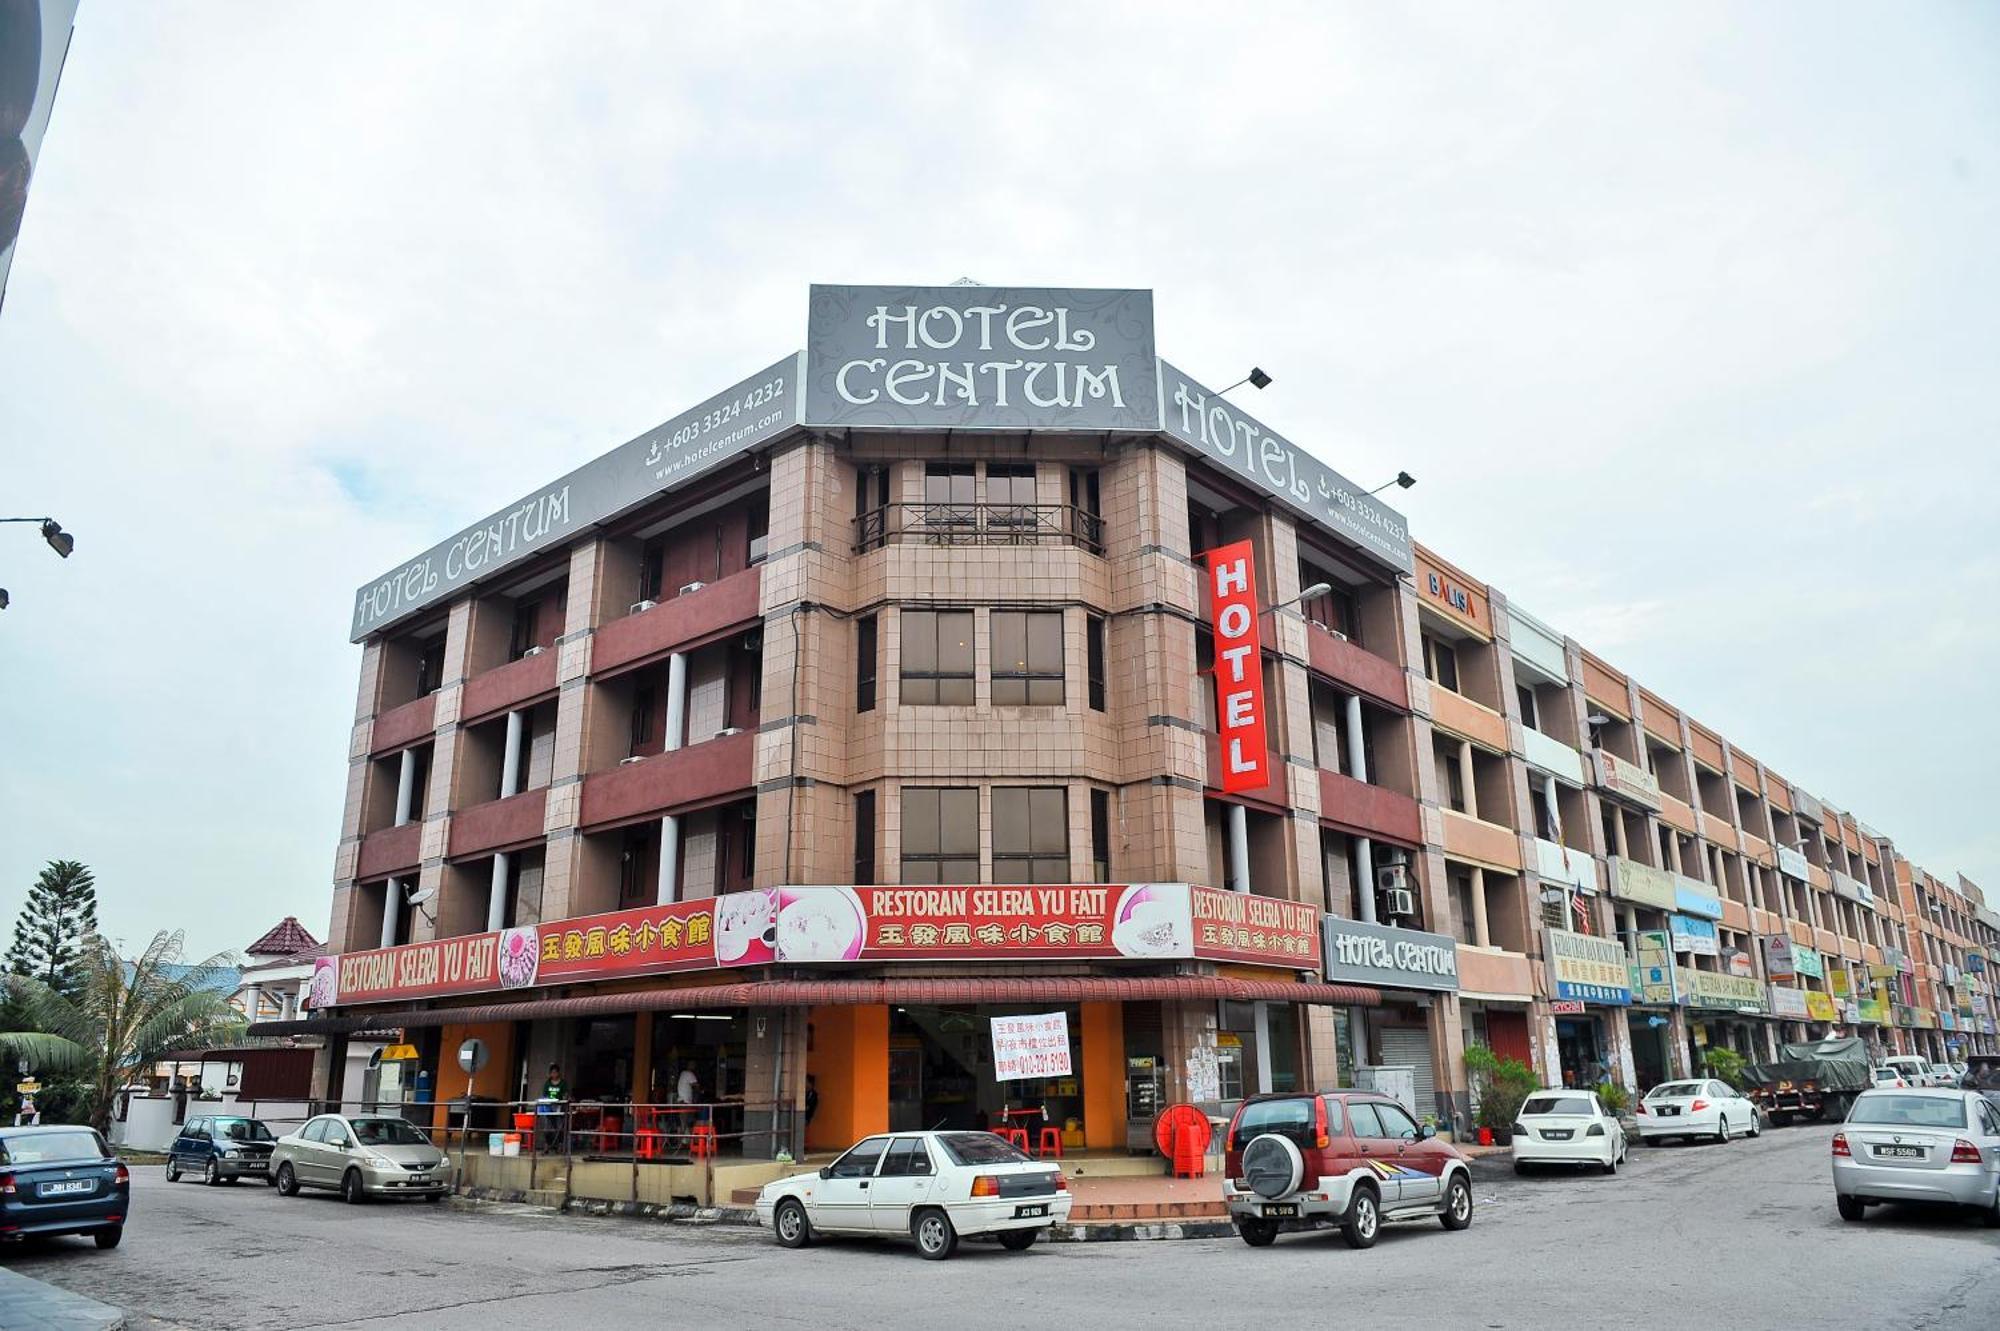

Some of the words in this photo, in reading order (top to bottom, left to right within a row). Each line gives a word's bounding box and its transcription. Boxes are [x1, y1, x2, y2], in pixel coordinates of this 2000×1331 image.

[866, 304, 1096, 351] HOTEL
[835, 358, 1126, 408] CENTUM
[663, 421, 700, 452] +603
[703, 399, 741, 434] 3324
[743, 377, 784, 411] 4232
[655, 410, 782, 480] www.hotelcentum.com
[1174, 381, 1311, 503] HOTEL
[1331, 488, 1356, 512] +603
[1358, 500, 1382, 528] 3324
[1383, 519, 1407, 543] 4232
[359, 556, 438, 627] HOTEL
[446, 484, 570, 580] CENTUM
[1429, 573, 1476, 618] BALISA
[1216, 557, 1258, 774] HOTEL
[872, 890, 967, 917] RESTORAN
[973, 890, 1035, 917] SELERA
[1038, 890, 1065, 916] YU
[1070, 889, 1108, 916] FATT
[1193, 891, 1247, 925] RESTORAN
[1248, 899, 1281, 930] SELERA
[1281, 904, 1296, 932] YU
[1297, 906, 1316, 935] FATT
[540, 911, 713, 961] 玉發風味小食館
[877, 923, 1105, 946] 玉發風味小食館
[1335, 933, 1393, 969] HOTEL
[1394, 942, 1457, 976] CENTUM
[340, 951, 397, 993] RESTORAN
[398, 946, 439, 988] SELERA
[443, 941, 463, 983] YU
[465, 937, 497, 981] FATT
